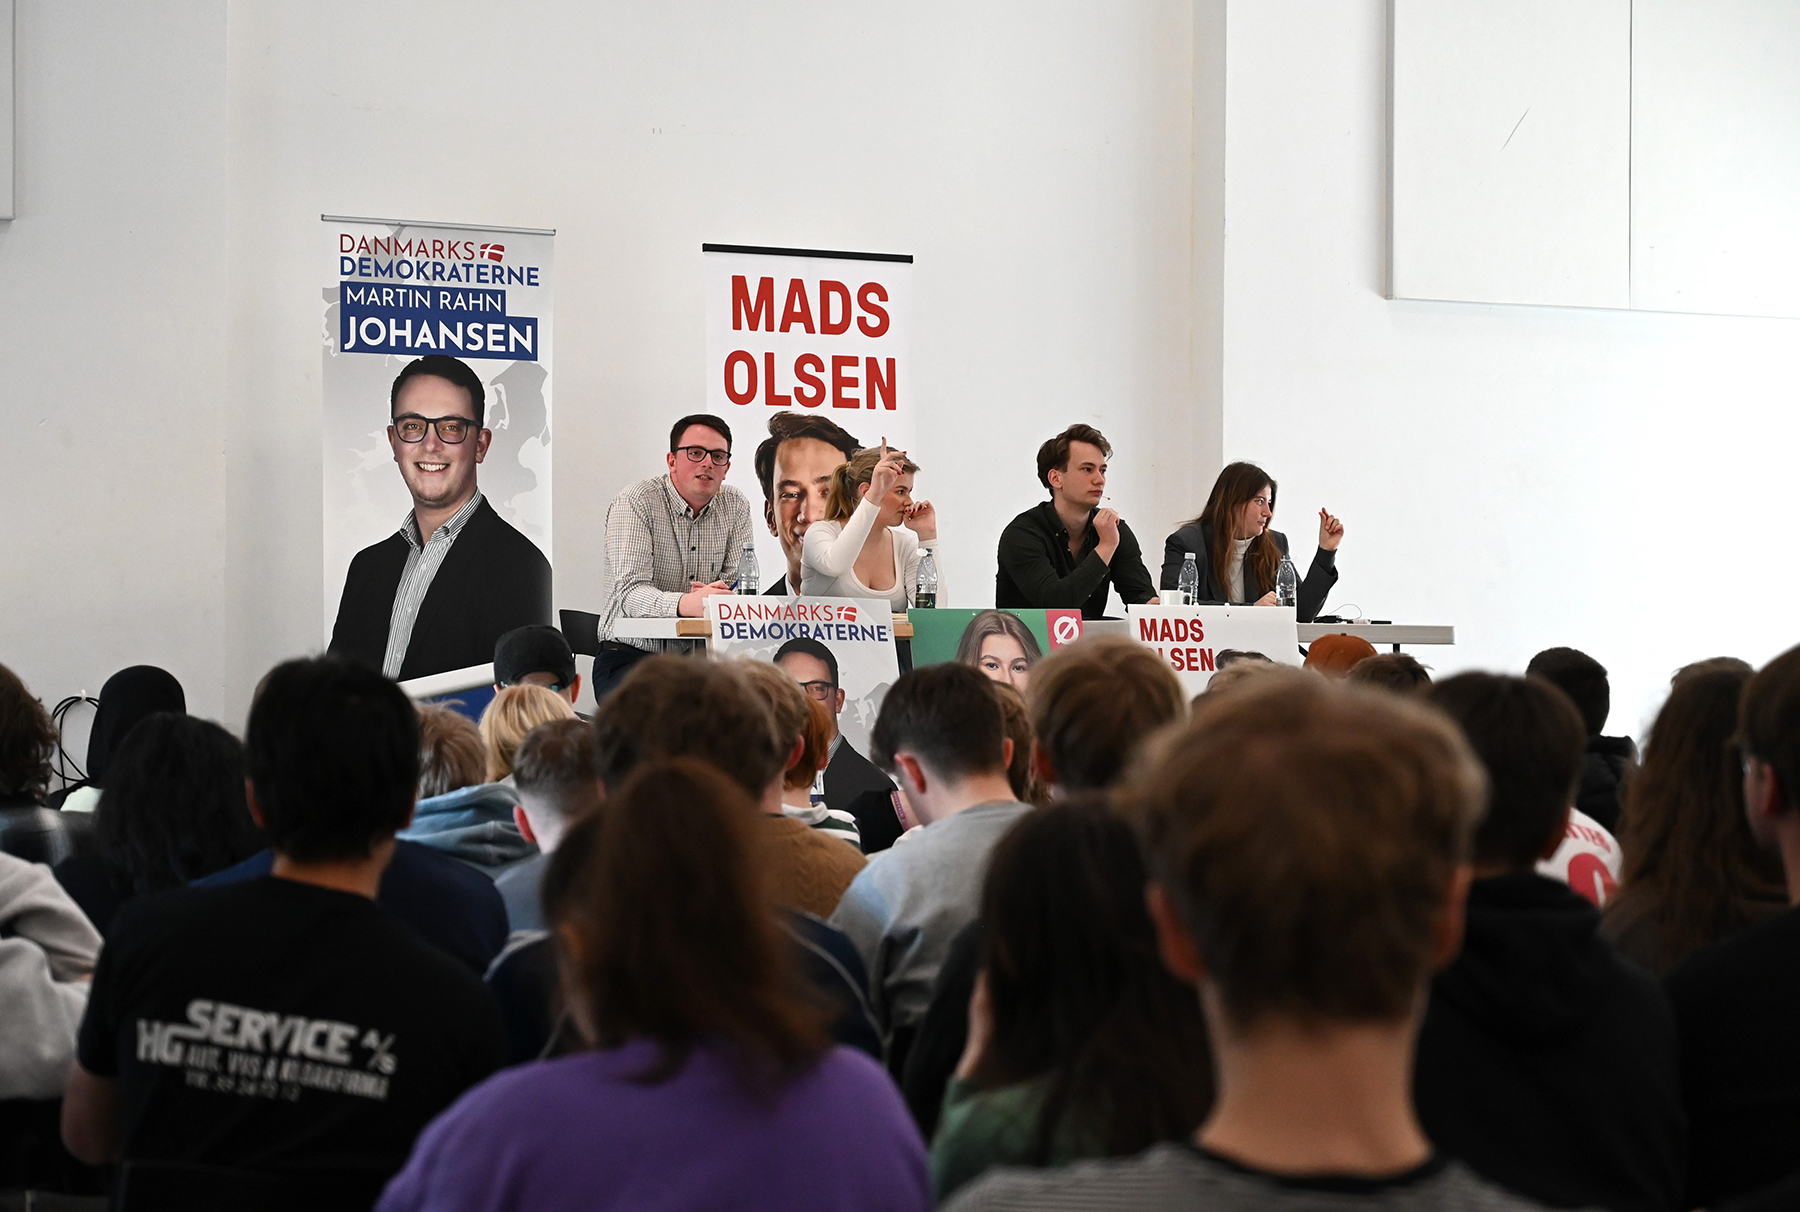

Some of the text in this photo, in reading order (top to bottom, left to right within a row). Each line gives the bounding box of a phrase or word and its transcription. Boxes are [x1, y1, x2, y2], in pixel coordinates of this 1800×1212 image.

[339, 233, 475, 261] DANMARKS
[340, 256, 540, 287] DEMOKRATERNE
[346, 286, 501, 312] MARTIN RAHN
[731, 274, 890, 338] MADS
[344, 316, 533, 354] JOHANSEN
[724, 349, 897, 411] OLSEN
[718, 603, 834, 622] DANMARKS
[720, 622, 889, 642] DEMOKRATERNE
[1139, 618, 1205, 642] MADS
[1146, 647, 1215, 671] SEN
[185, 999, 359, 1064] SERVICE
